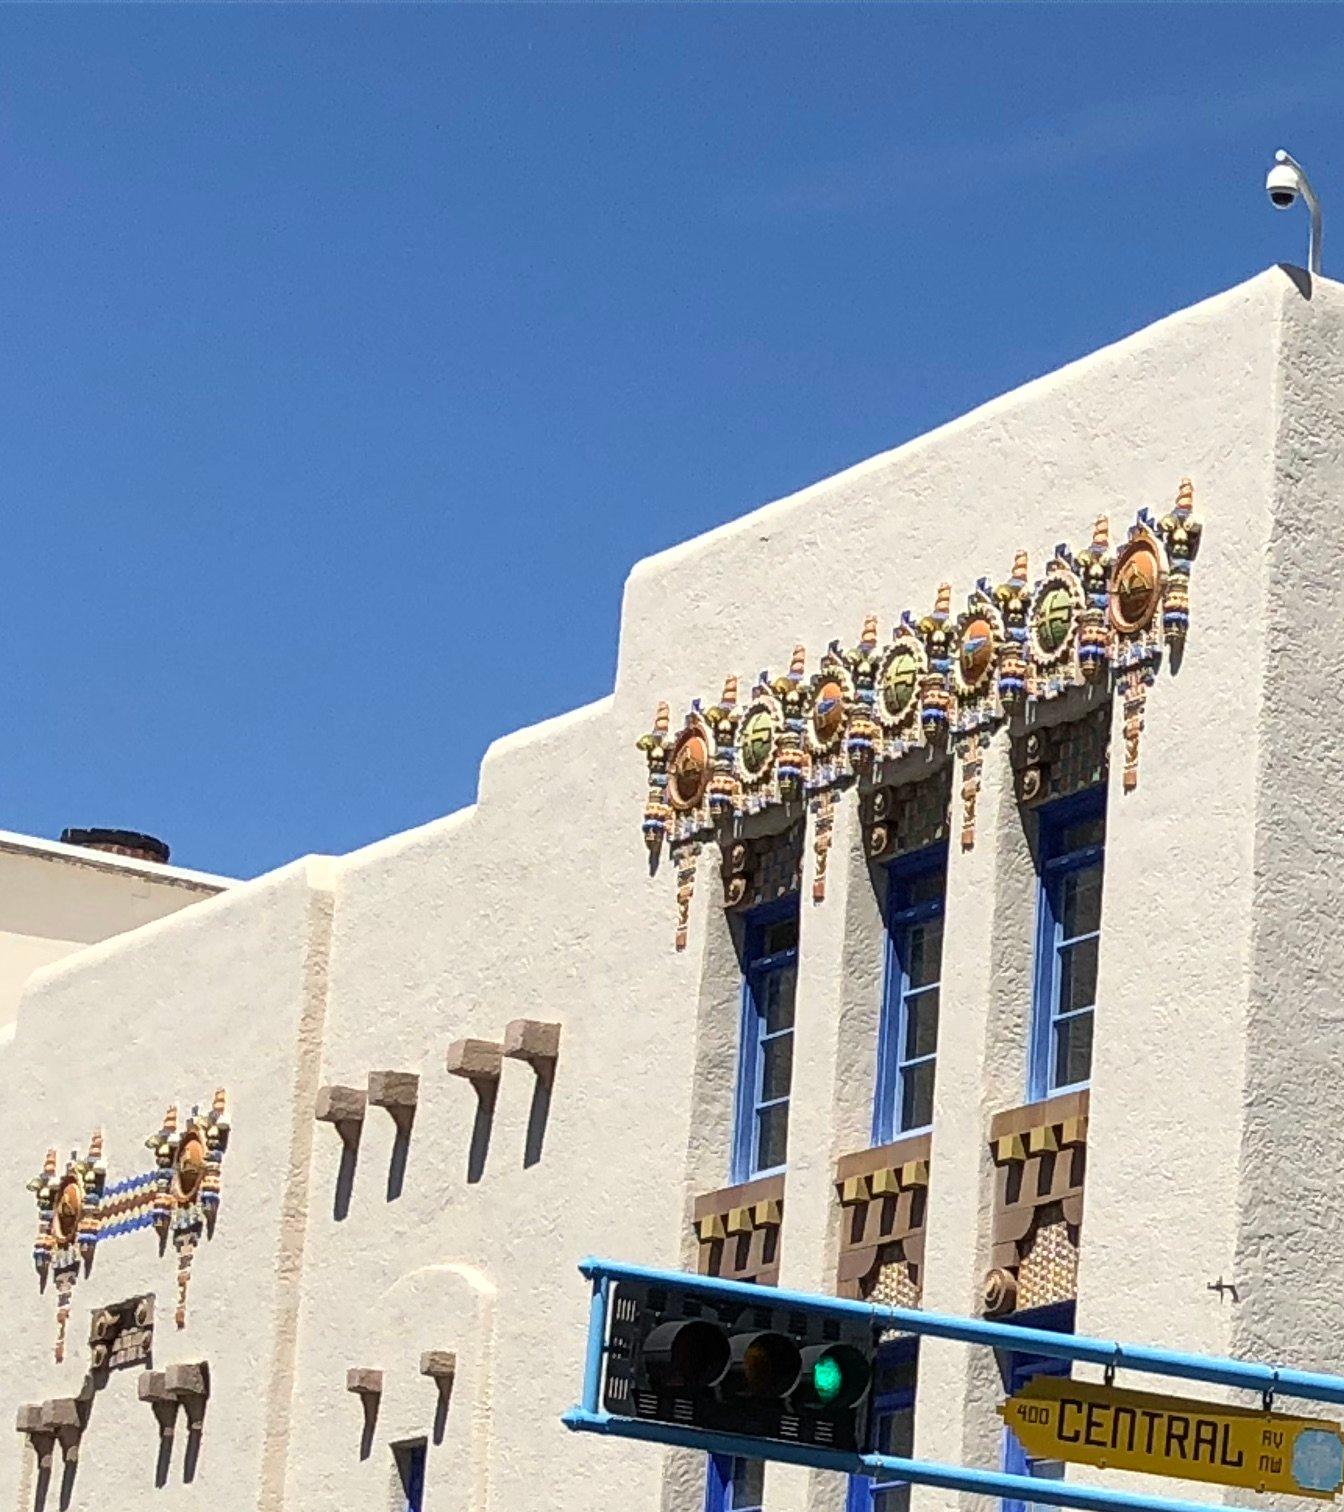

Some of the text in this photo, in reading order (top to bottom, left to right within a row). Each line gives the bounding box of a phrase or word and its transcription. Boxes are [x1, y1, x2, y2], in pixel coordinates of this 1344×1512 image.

[1016, 1398, 1244, 1468] 400 CENTRAL
[1261, 1429, 1284, 1449] AV
